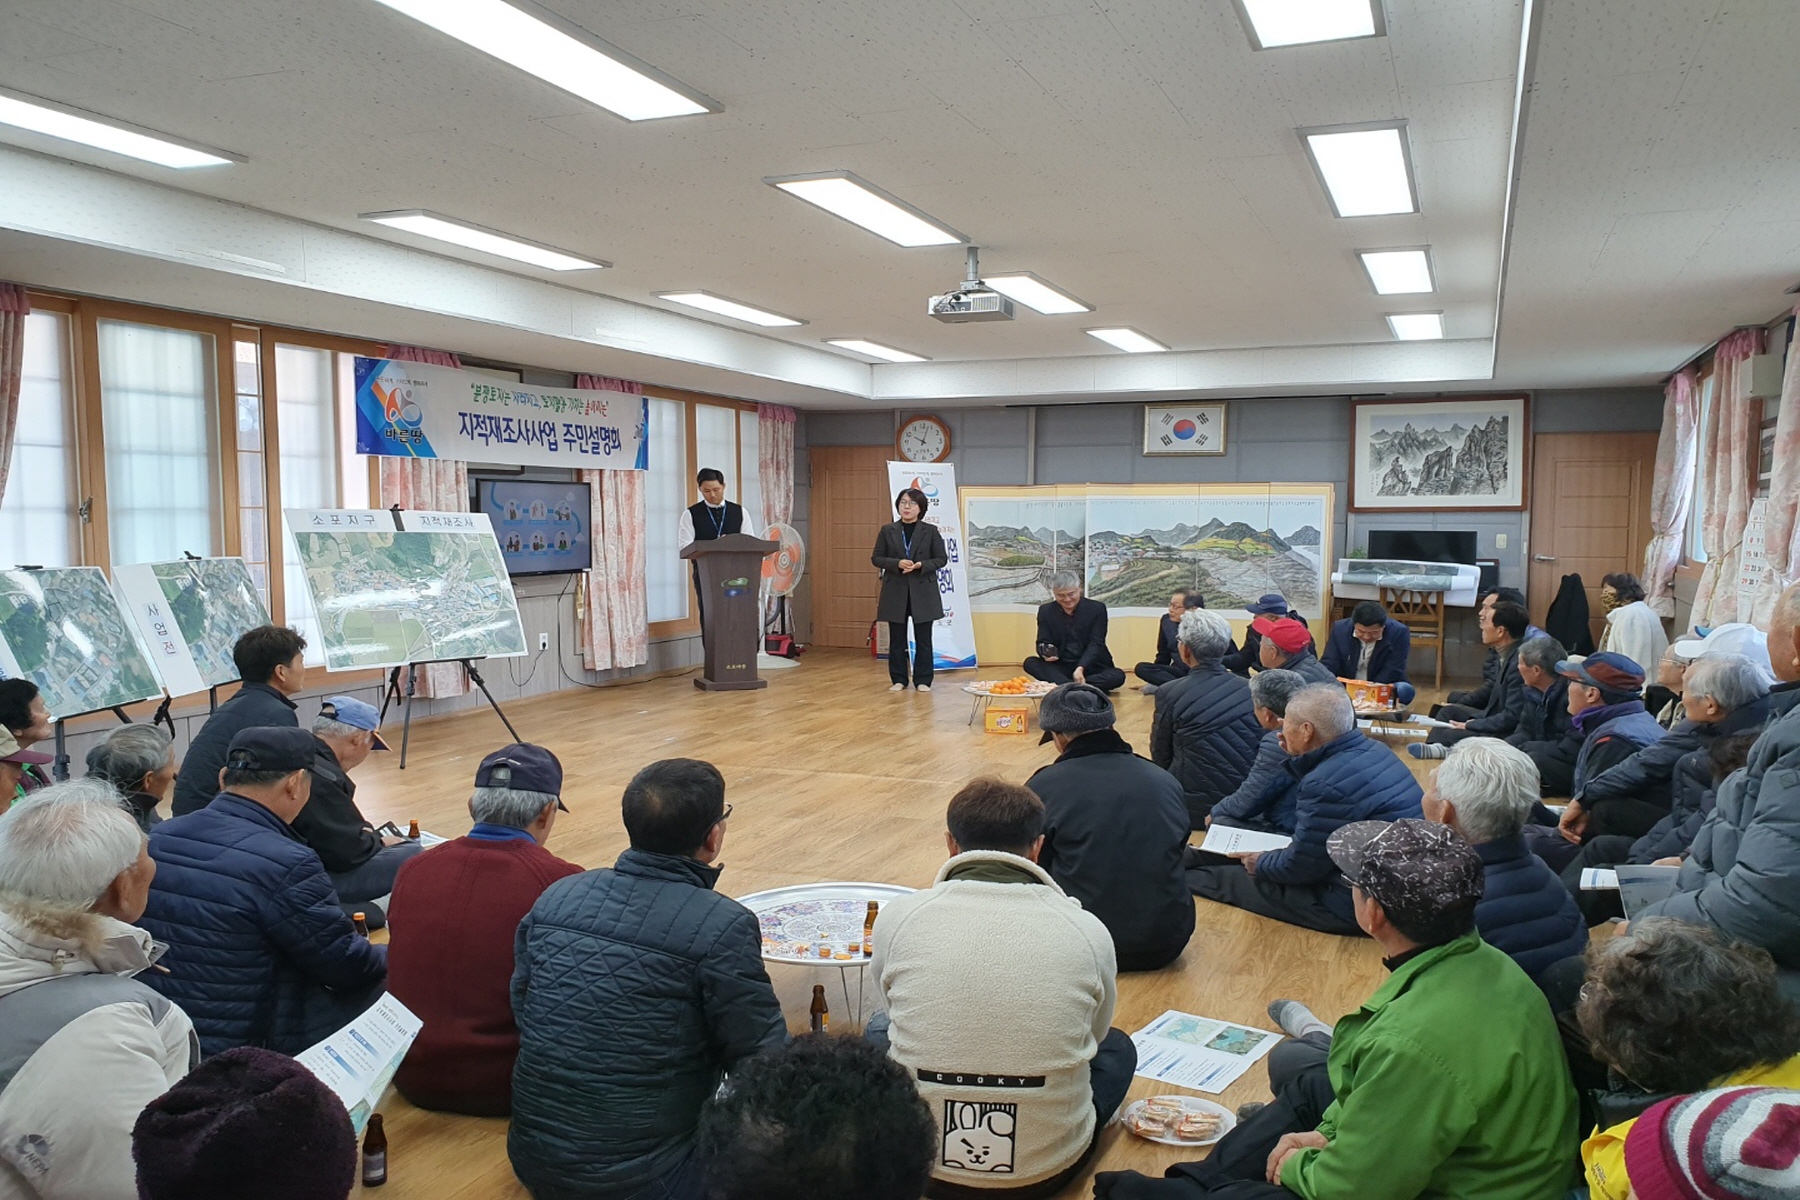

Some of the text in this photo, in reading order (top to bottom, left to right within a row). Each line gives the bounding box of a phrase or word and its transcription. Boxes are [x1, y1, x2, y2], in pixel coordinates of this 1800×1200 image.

[385, 428, 423, 444] 바른땅
[458, 412, 558, 451] 지적재조사사업
[562, 423, 621, 456] 주민설명회
[312, 514, 376, 526] 소포지구
[419, 516, 474, 527] 지적재조사
[936, 1073, 1026, 1085] COOKY
[24, 1152, 50, 1176] NEPA
